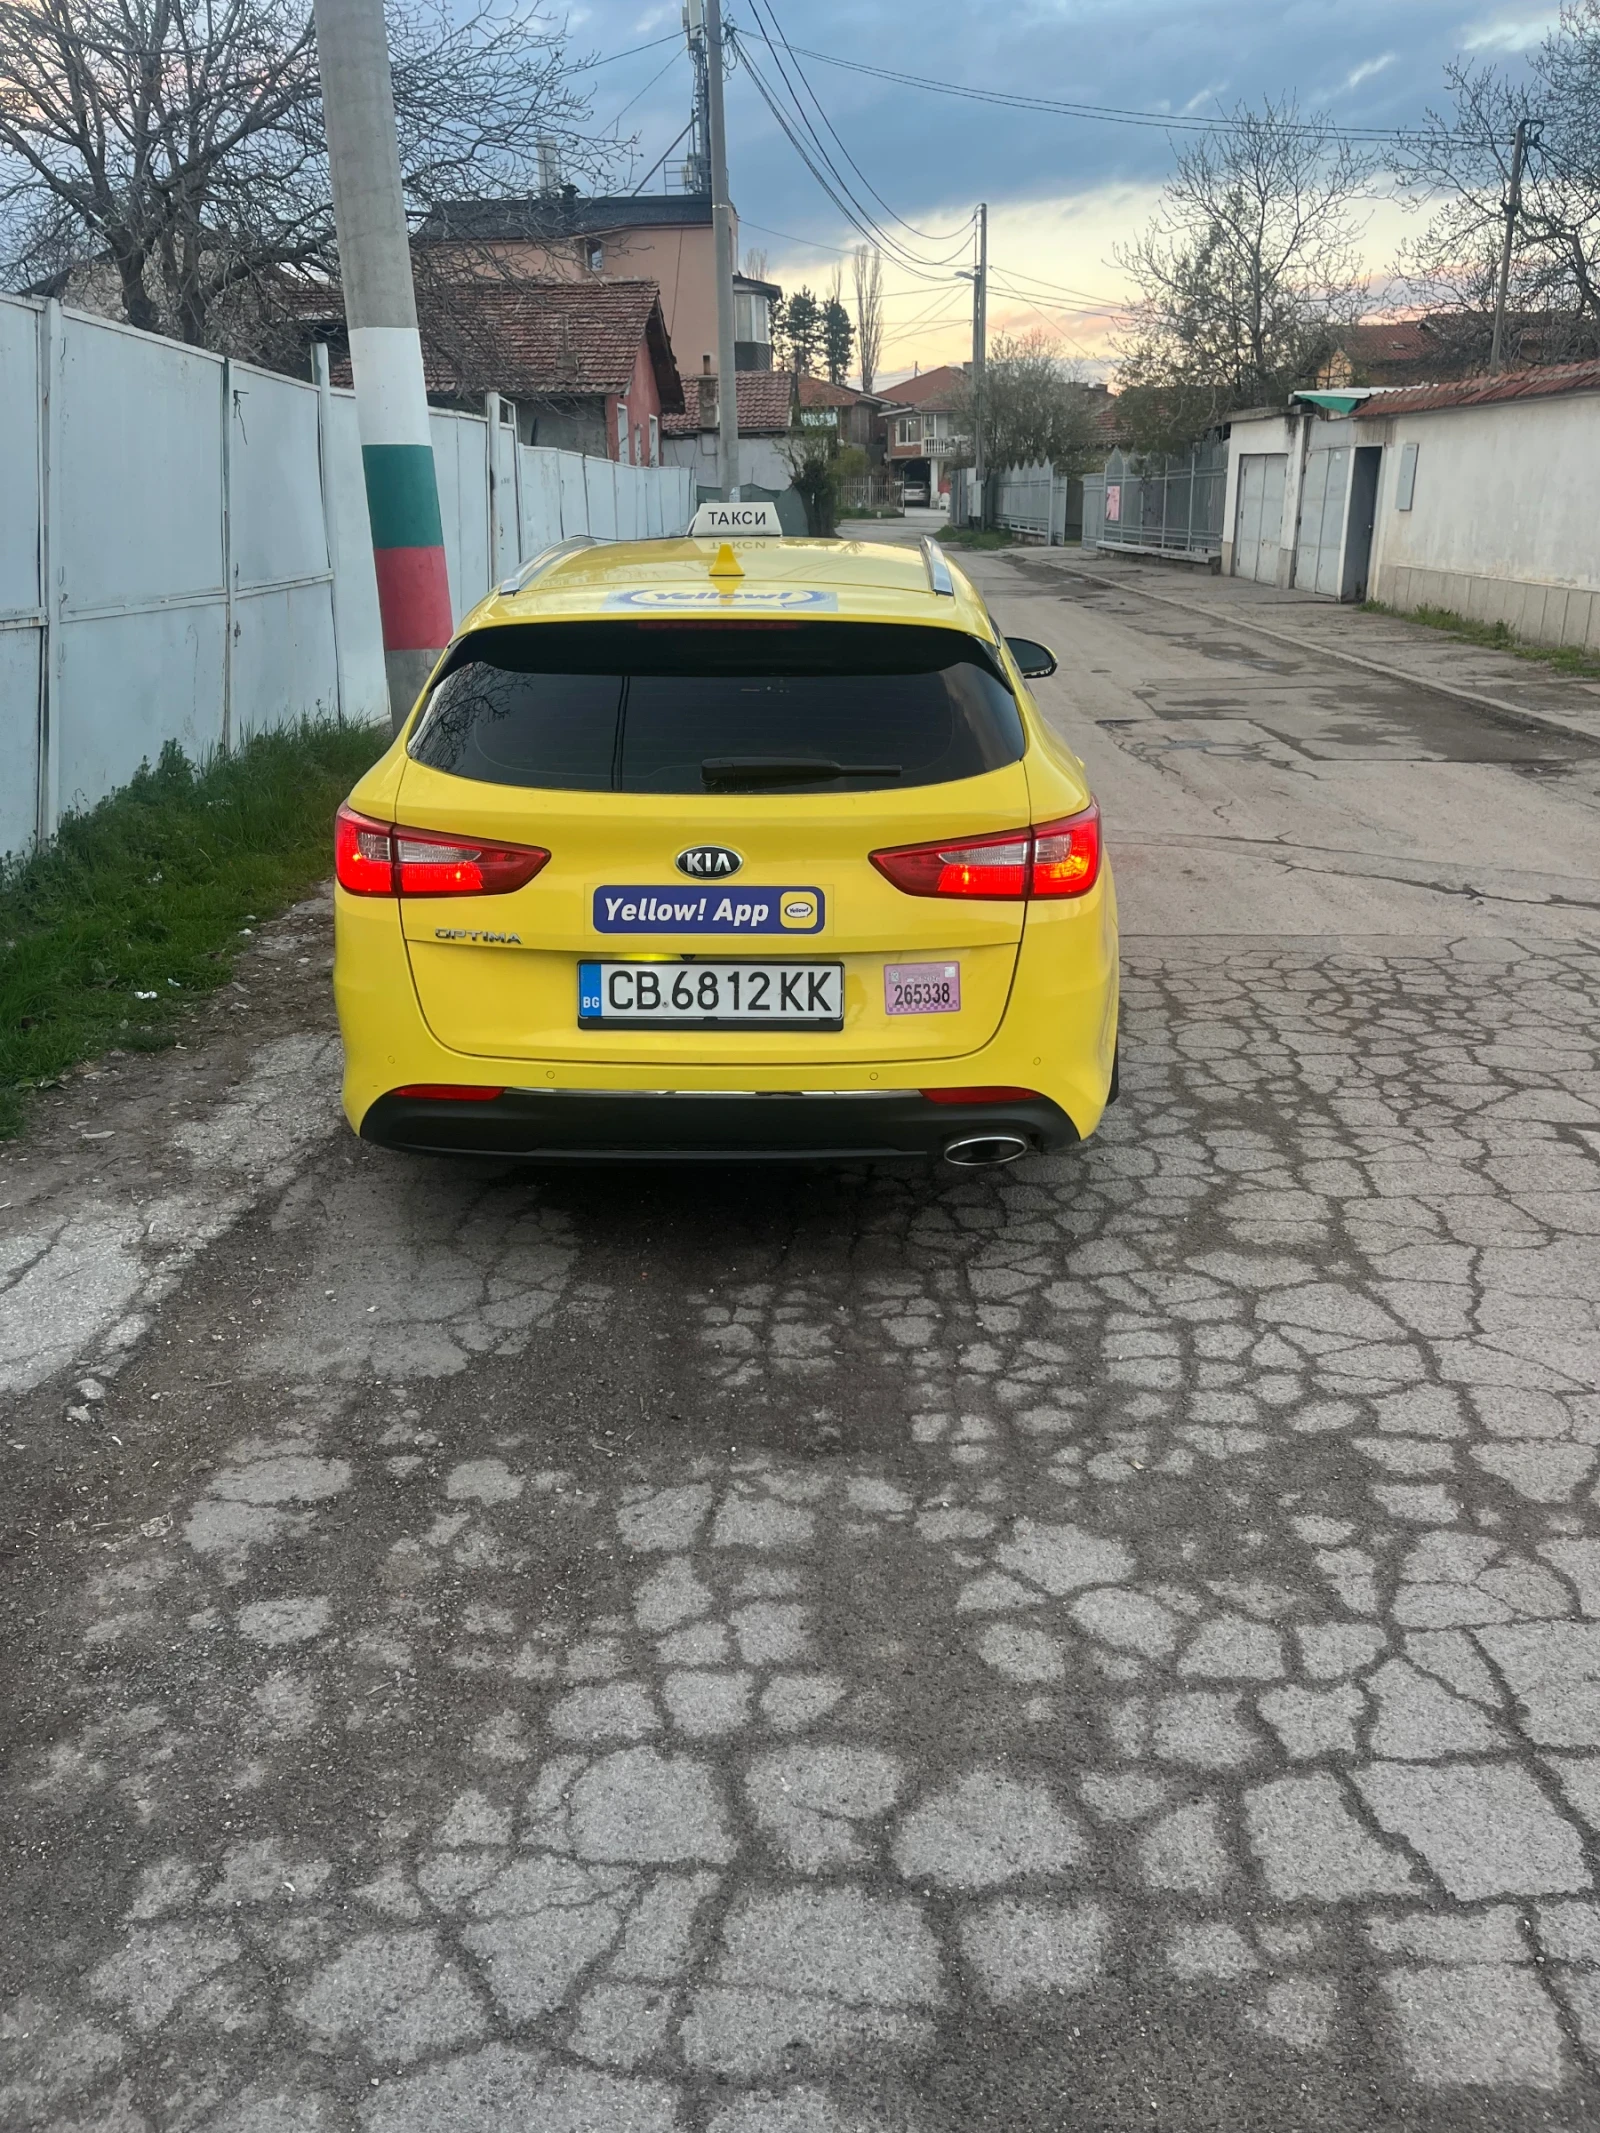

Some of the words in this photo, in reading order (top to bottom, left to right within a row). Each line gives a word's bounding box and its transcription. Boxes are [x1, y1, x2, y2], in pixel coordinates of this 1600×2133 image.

[708, 511, 767, 525] ТАКСИ
[654, 592, 793, 600] Yellow!
[686, 852, 732, 872] KIA
[605, 898, 707, 921] Yellow!
[712, 898, 769, 927] App
[435, 928, 523, 945] OPTIMA
[583, 996, 600, 1008] BG
[894, 982, 951, 1006] 265338
